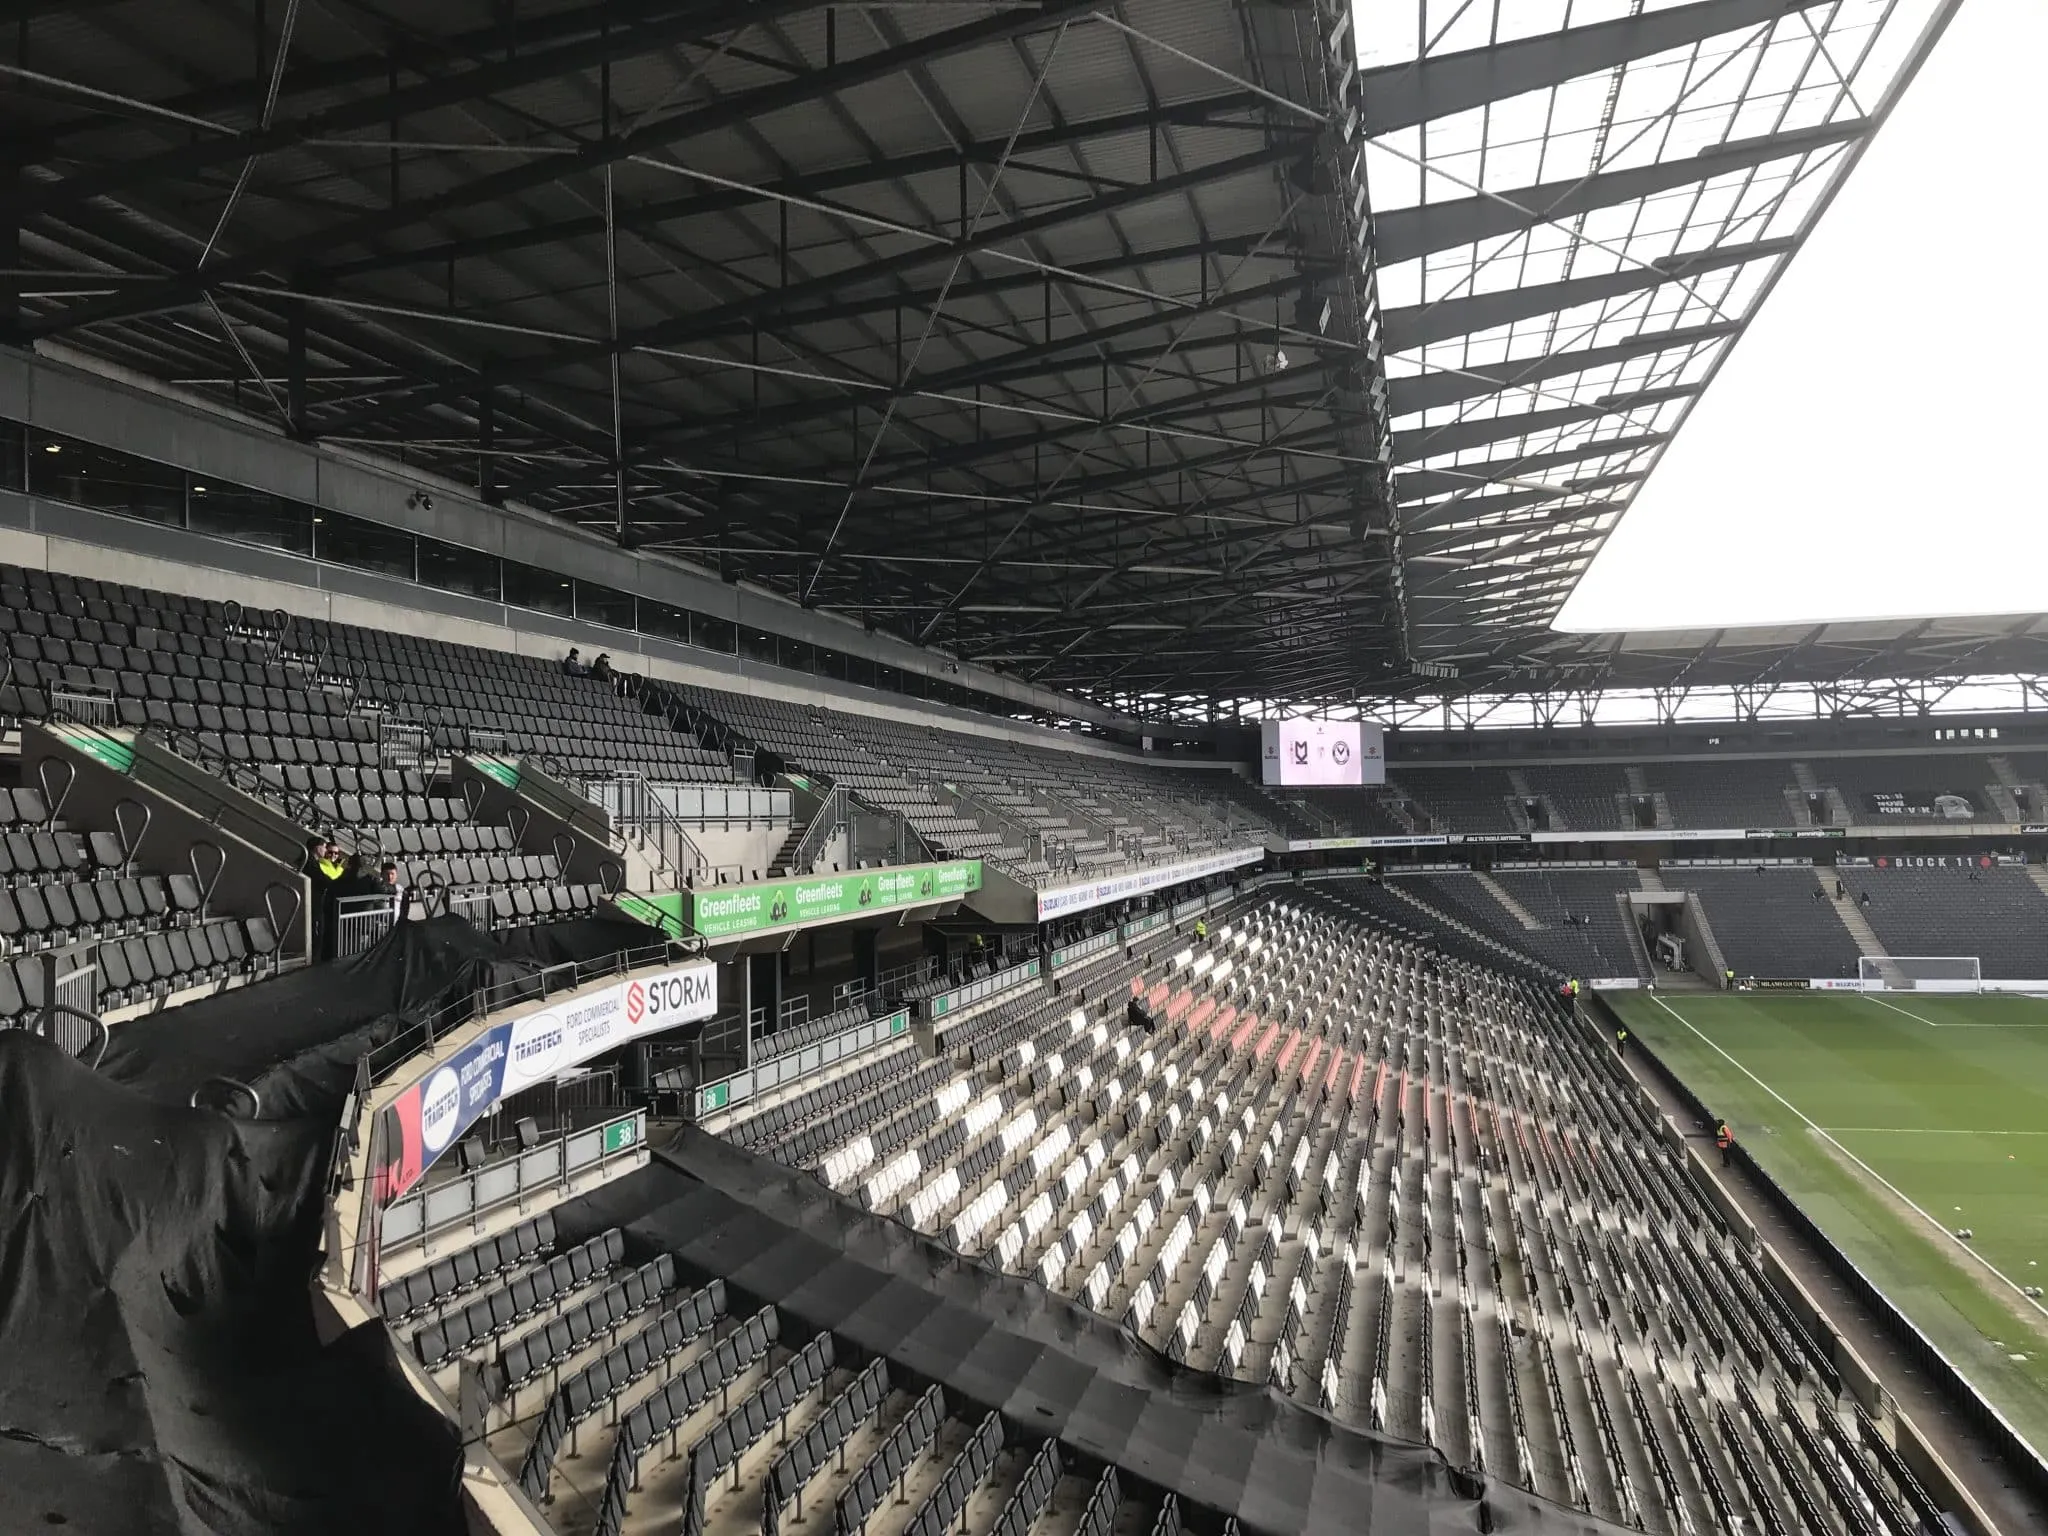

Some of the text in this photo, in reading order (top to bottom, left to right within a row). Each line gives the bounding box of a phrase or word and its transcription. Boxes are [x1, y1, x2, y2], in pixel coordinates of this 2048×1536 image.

[1895, 857, 1973, 867] BLOCK 11
[700, 893, 761, 918] Greenfleets
[796, 883, 843, 905] Greenfleets
[800, 906, 820, 918] VEHICLE
[704, 916, 758, 933] VEHICLE LEASING
[649, 972, 711, 1014] STORM
[567, 998, 620, 1030] FORD COMMERCIAL
[578, 1021, 610, 1046] SPECIALISTS
[461, 1040, 505, 1086] FORD COMMERCIAL
[469, 1070, 493, 1107] SPECIALISTS
[706, 1093, 717, 1109] 38
[618, 1126, 631, 1146] 38
